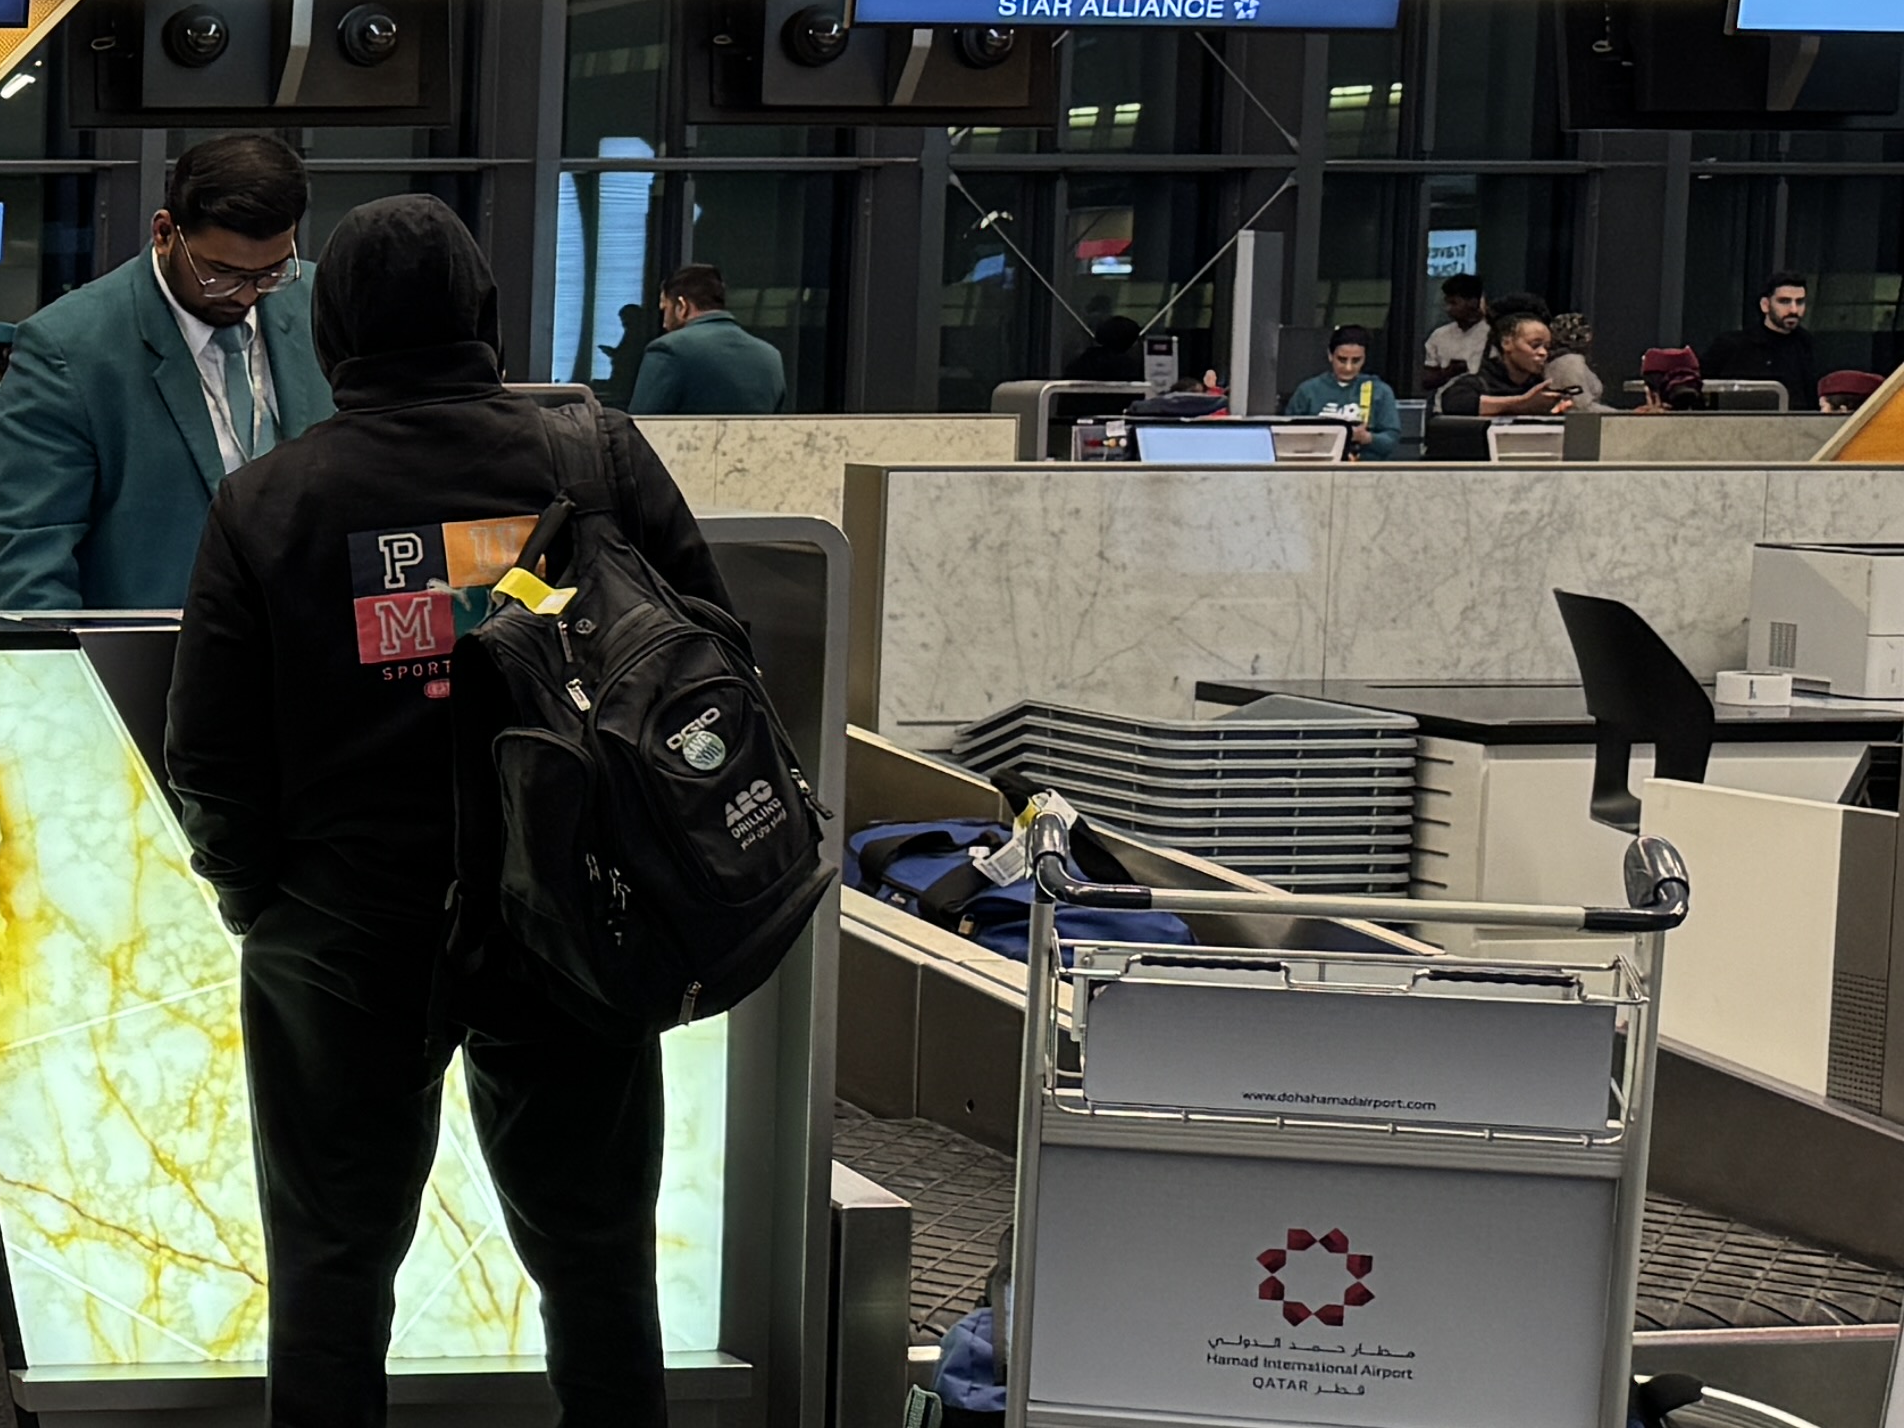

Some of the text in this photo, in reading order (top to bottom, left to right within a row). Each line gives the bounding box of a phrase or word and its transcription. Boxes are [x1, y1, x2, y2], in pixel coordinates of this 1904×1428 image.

[378, 532, 424, 590] P
[374, 597, 436, 656] M
[724, 779, 773, 828] ARO
[1242, 1091, 1437, 1111] www.dohahamadairport.com
[1207, 1334, 1416, 1359] مطار حمد الدولي
[1206, 1352, 1414, 1380] Hamad International Airport
[1252, 1376, 1308, 1392] QATAR
[1314, 1383, 1366, 1396] قطر
